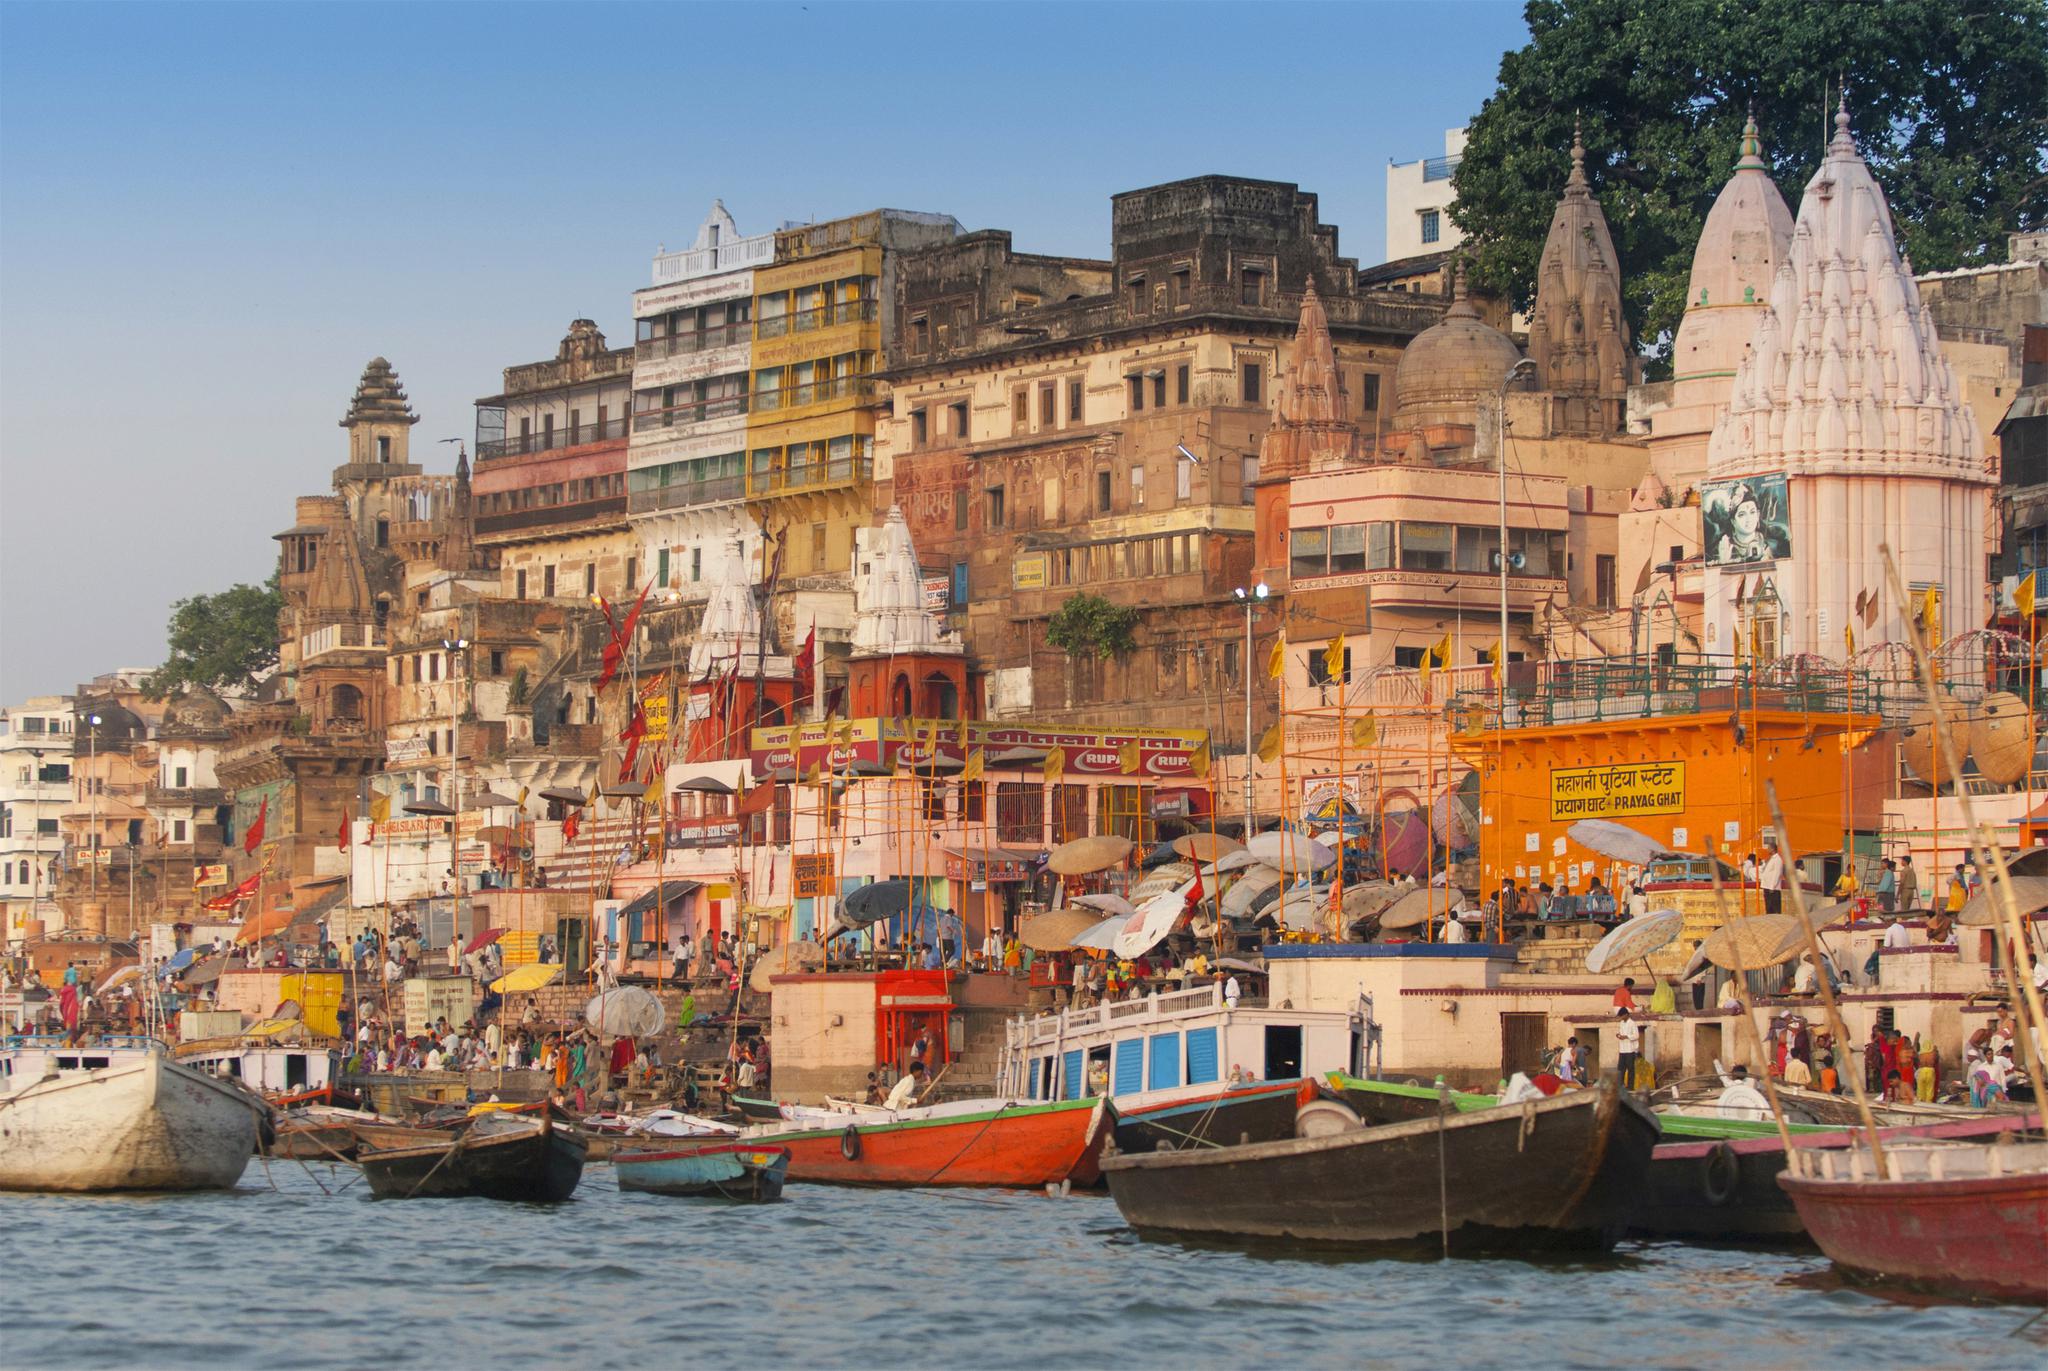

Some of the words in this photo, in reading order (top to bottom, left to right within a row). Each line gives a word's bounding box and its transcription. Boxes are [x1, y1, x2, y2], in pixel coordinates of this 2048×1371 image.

[1158, 756, 1190, 766] RUP
[1555, 798, 1586, 815] प्रयाग
[1587, 797, 1606, 812] घाट
[1614, 793, 1655, 810] PRAYAG
[1656, 791, 1682, 806] GHAT
